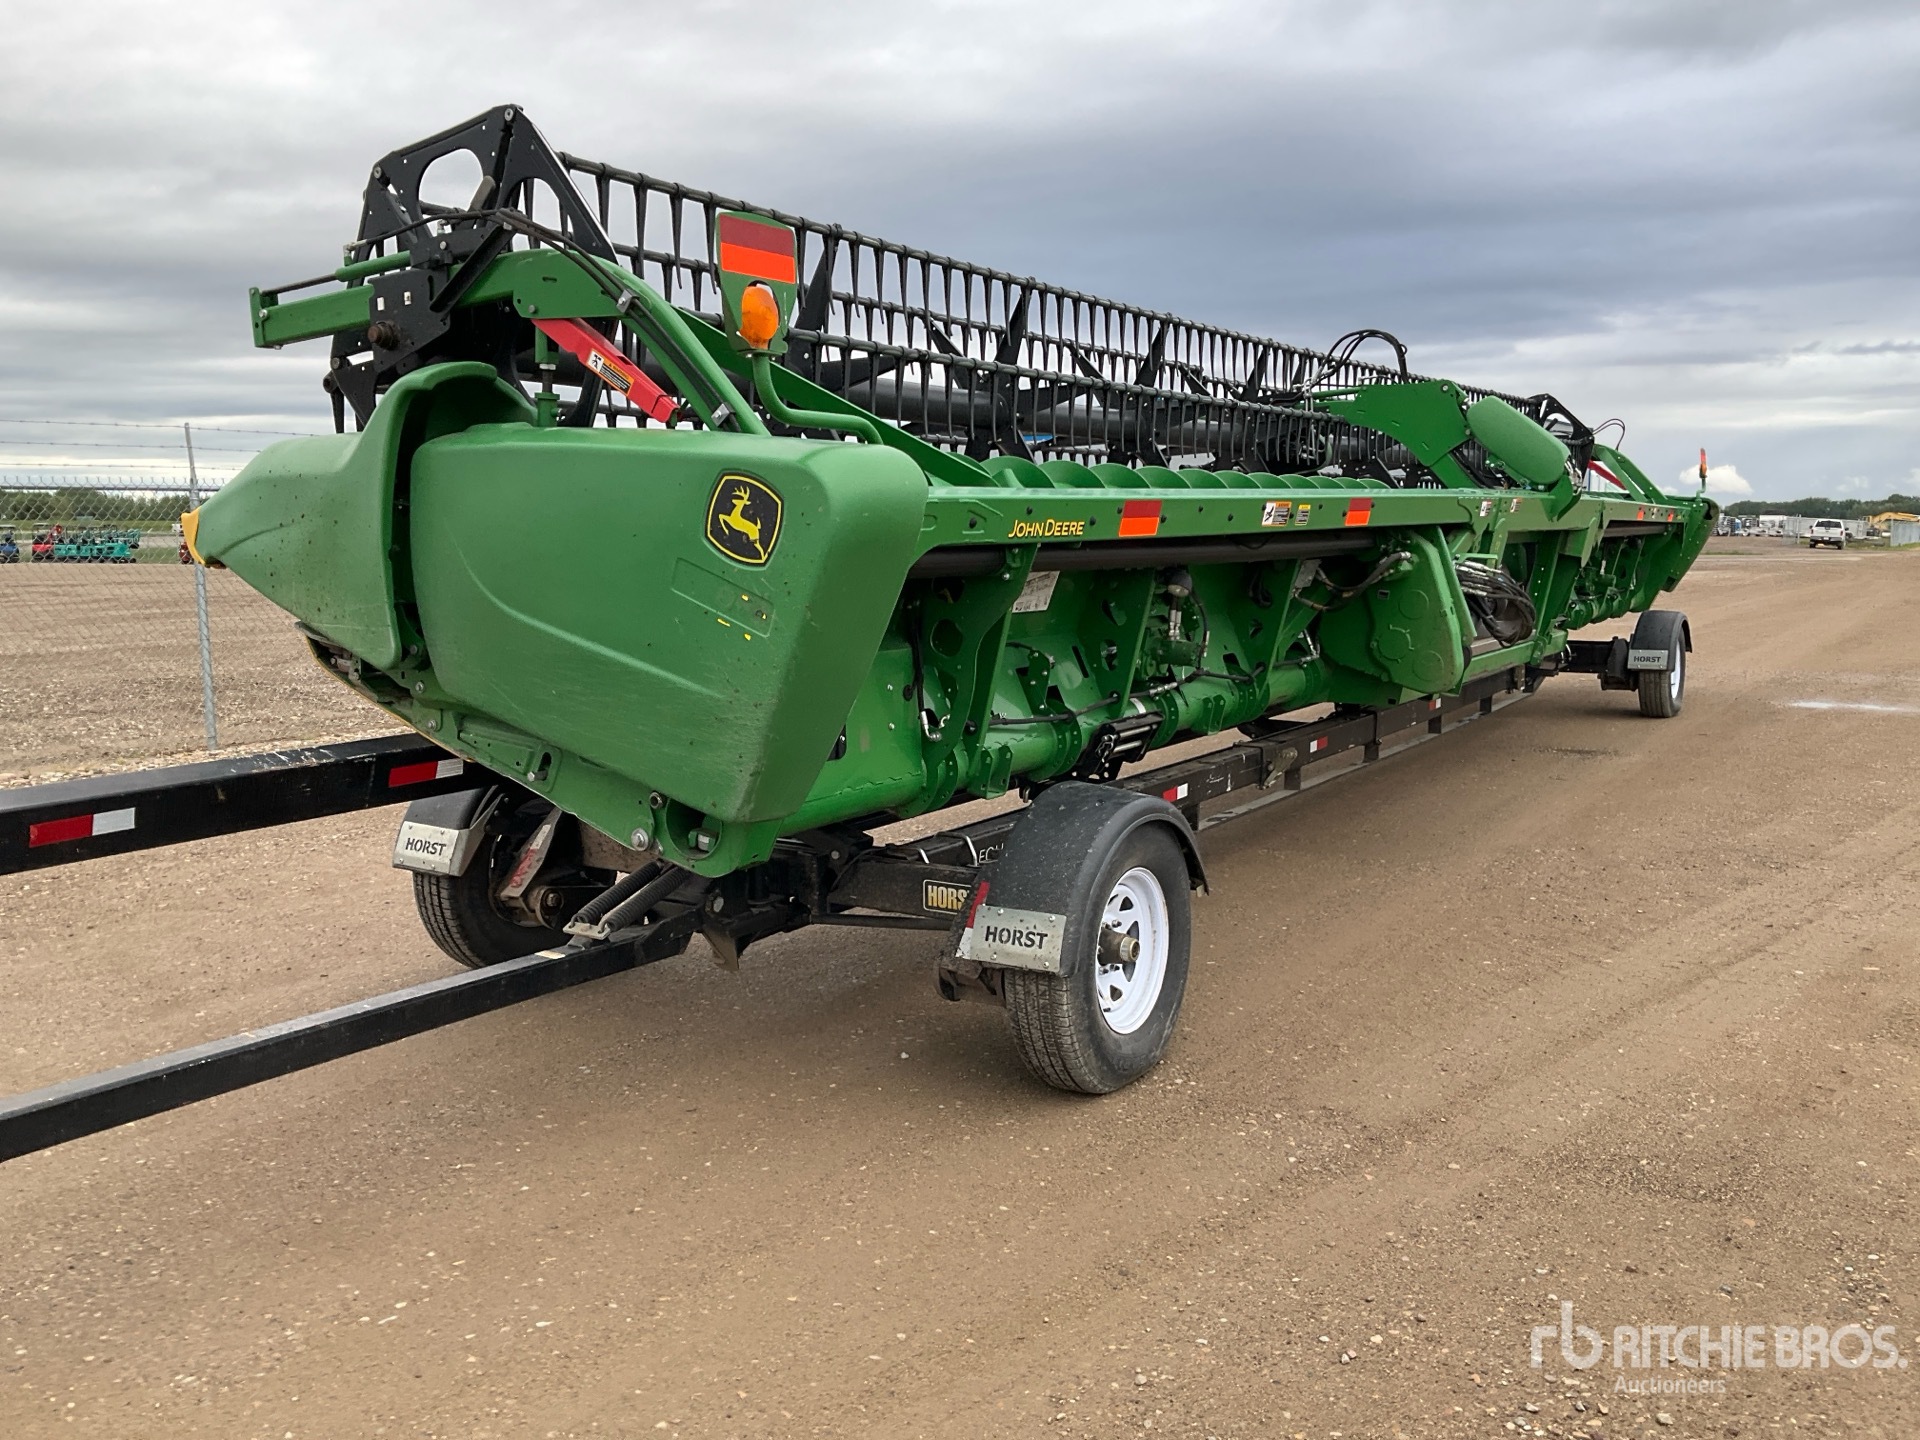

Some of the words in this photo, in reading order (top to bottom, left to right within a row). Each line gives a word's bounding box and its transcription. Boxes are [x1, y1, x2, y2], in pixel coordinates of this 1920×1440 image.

[1008, 520, 1044, 538] JOHN
[1044, 519, 1085, 537] DEERE
[405, 837, 446, 856] HORST
[927, 885, 969, 910] HORS
[985, 926, 1048, 949] HORST
